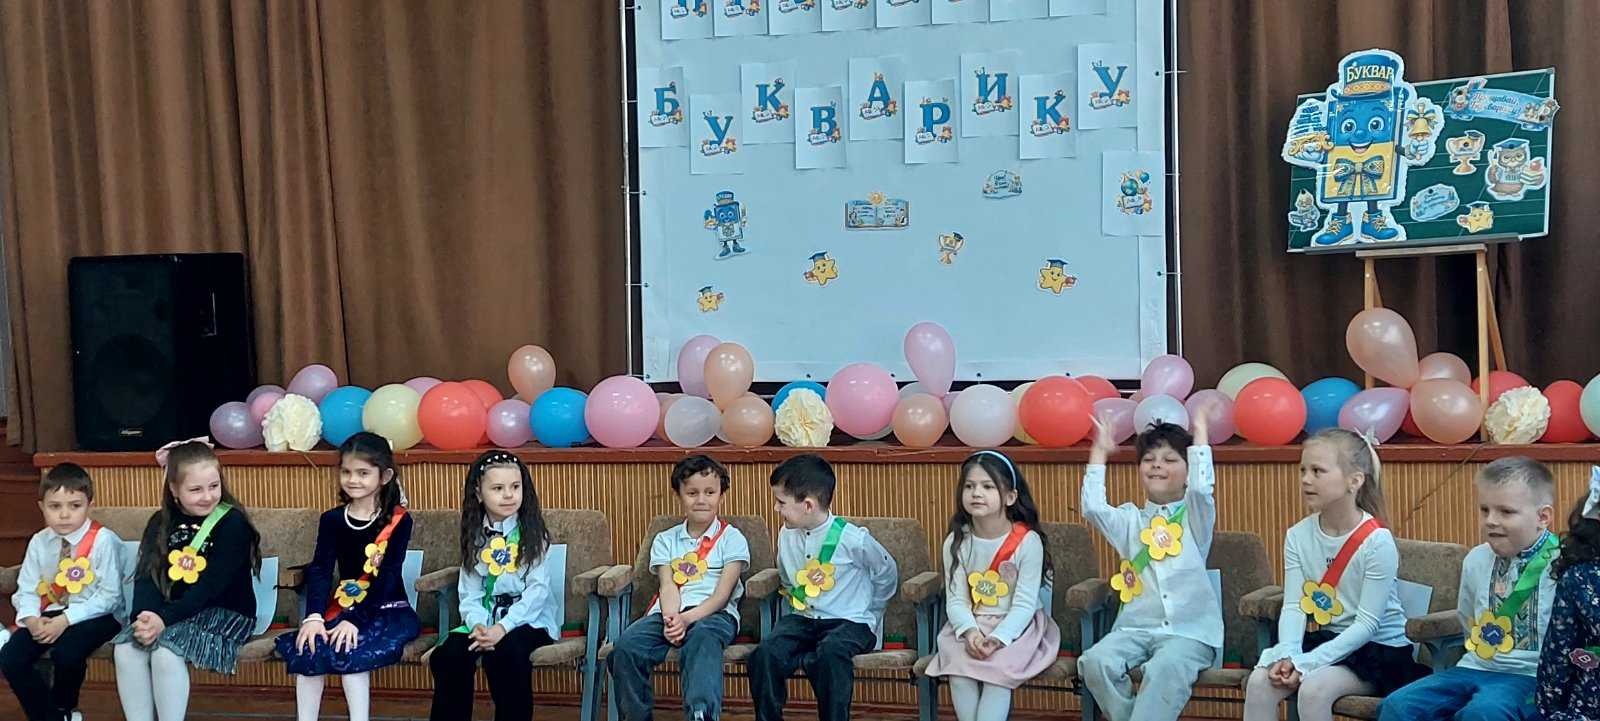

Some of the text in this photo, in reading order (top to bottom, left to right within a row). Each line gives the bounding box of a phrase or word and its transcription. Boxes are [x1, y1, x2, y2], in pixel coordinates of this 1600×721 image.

[654, 66, 1127, 146] БУКВАРИКУ
[182, 557, 192, 568] М
[71, 568, 81, 577] О
[980, 582, 991, 593] Ж
[1316, 595, 1327, 606] Д
[1578, 654, 1591, 663] В
